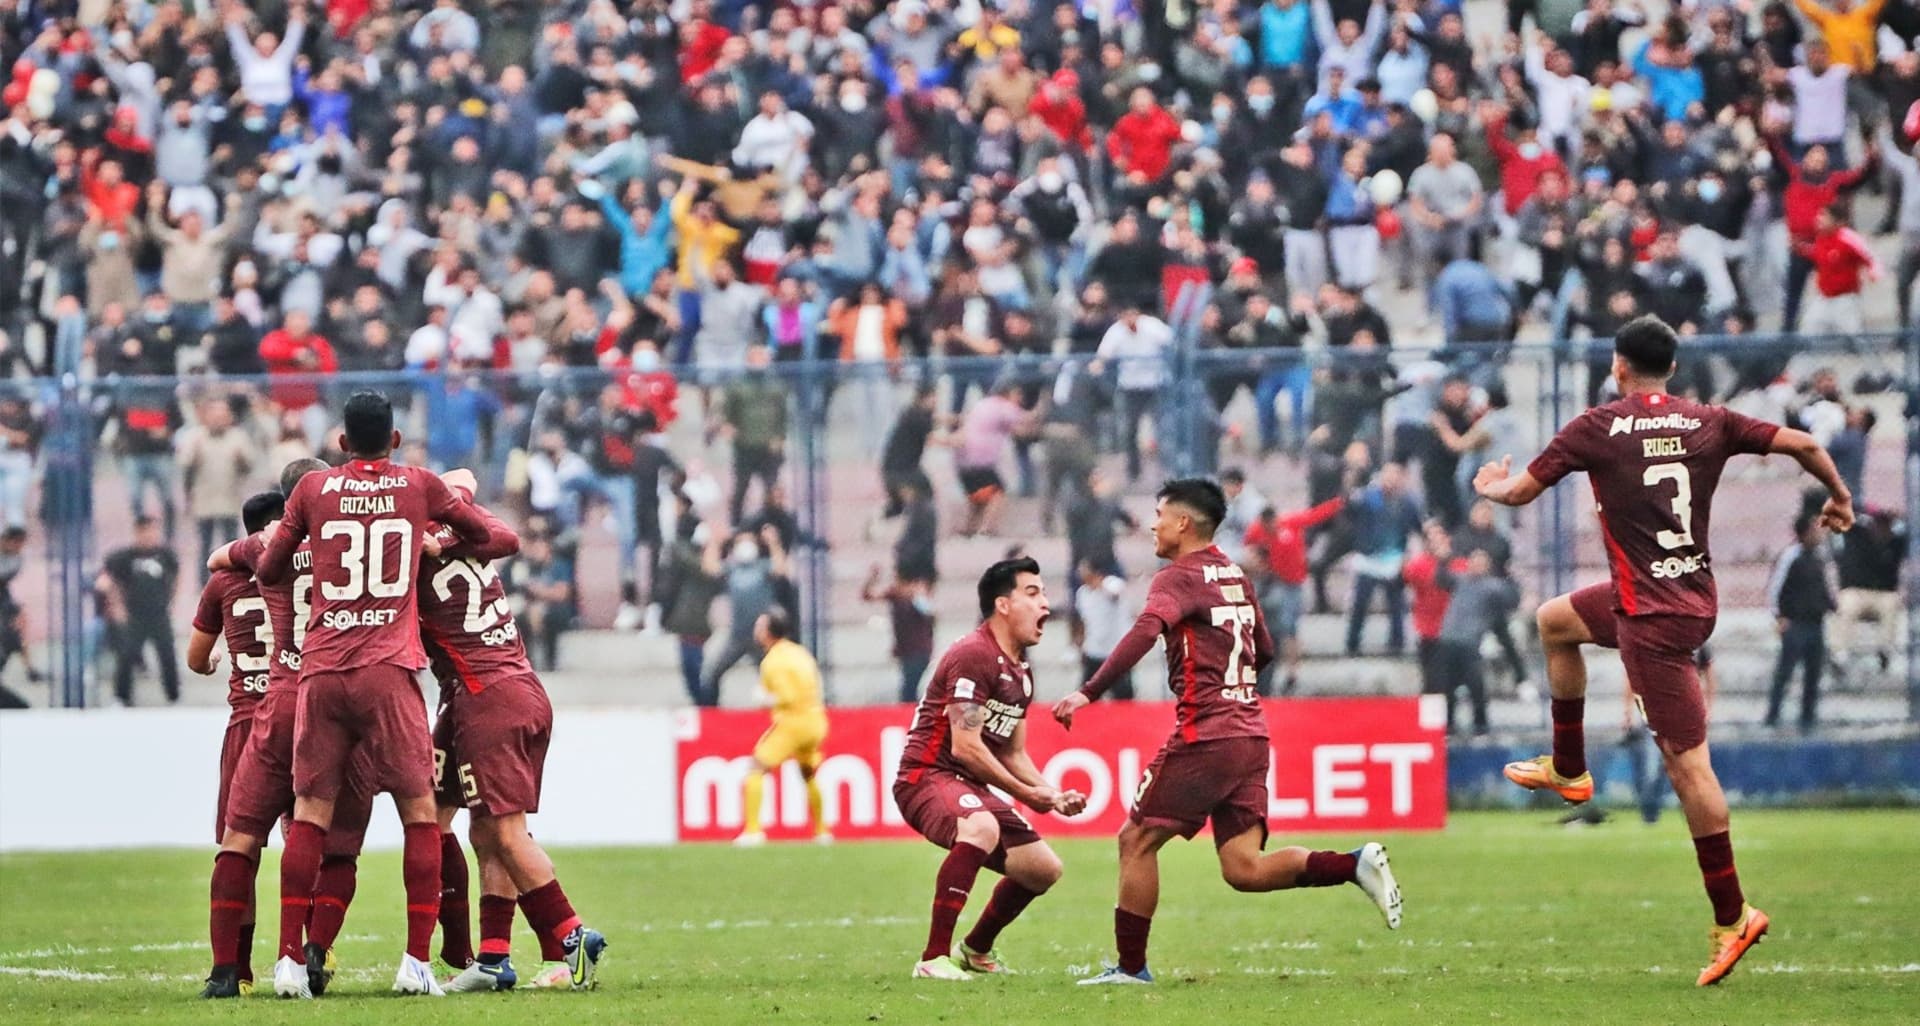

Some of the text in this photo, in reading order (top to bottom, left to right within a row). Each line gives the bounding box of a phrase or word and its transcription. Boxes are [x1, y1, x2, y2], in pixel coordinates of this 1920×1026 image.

[1634, 412, 1702, 431] movilbus
[1642, 436, 1687, 458] RUGEL
[344, 475, 408, 492] movilbus
[339, 495, 396, 515] GUZMAN
[1643, 461, 1695, 551] 3
[320, 518, 413, 600] 30
[322, 608, 398, 631] SOLBET
[1041, 741, 1434, 826] OULET
